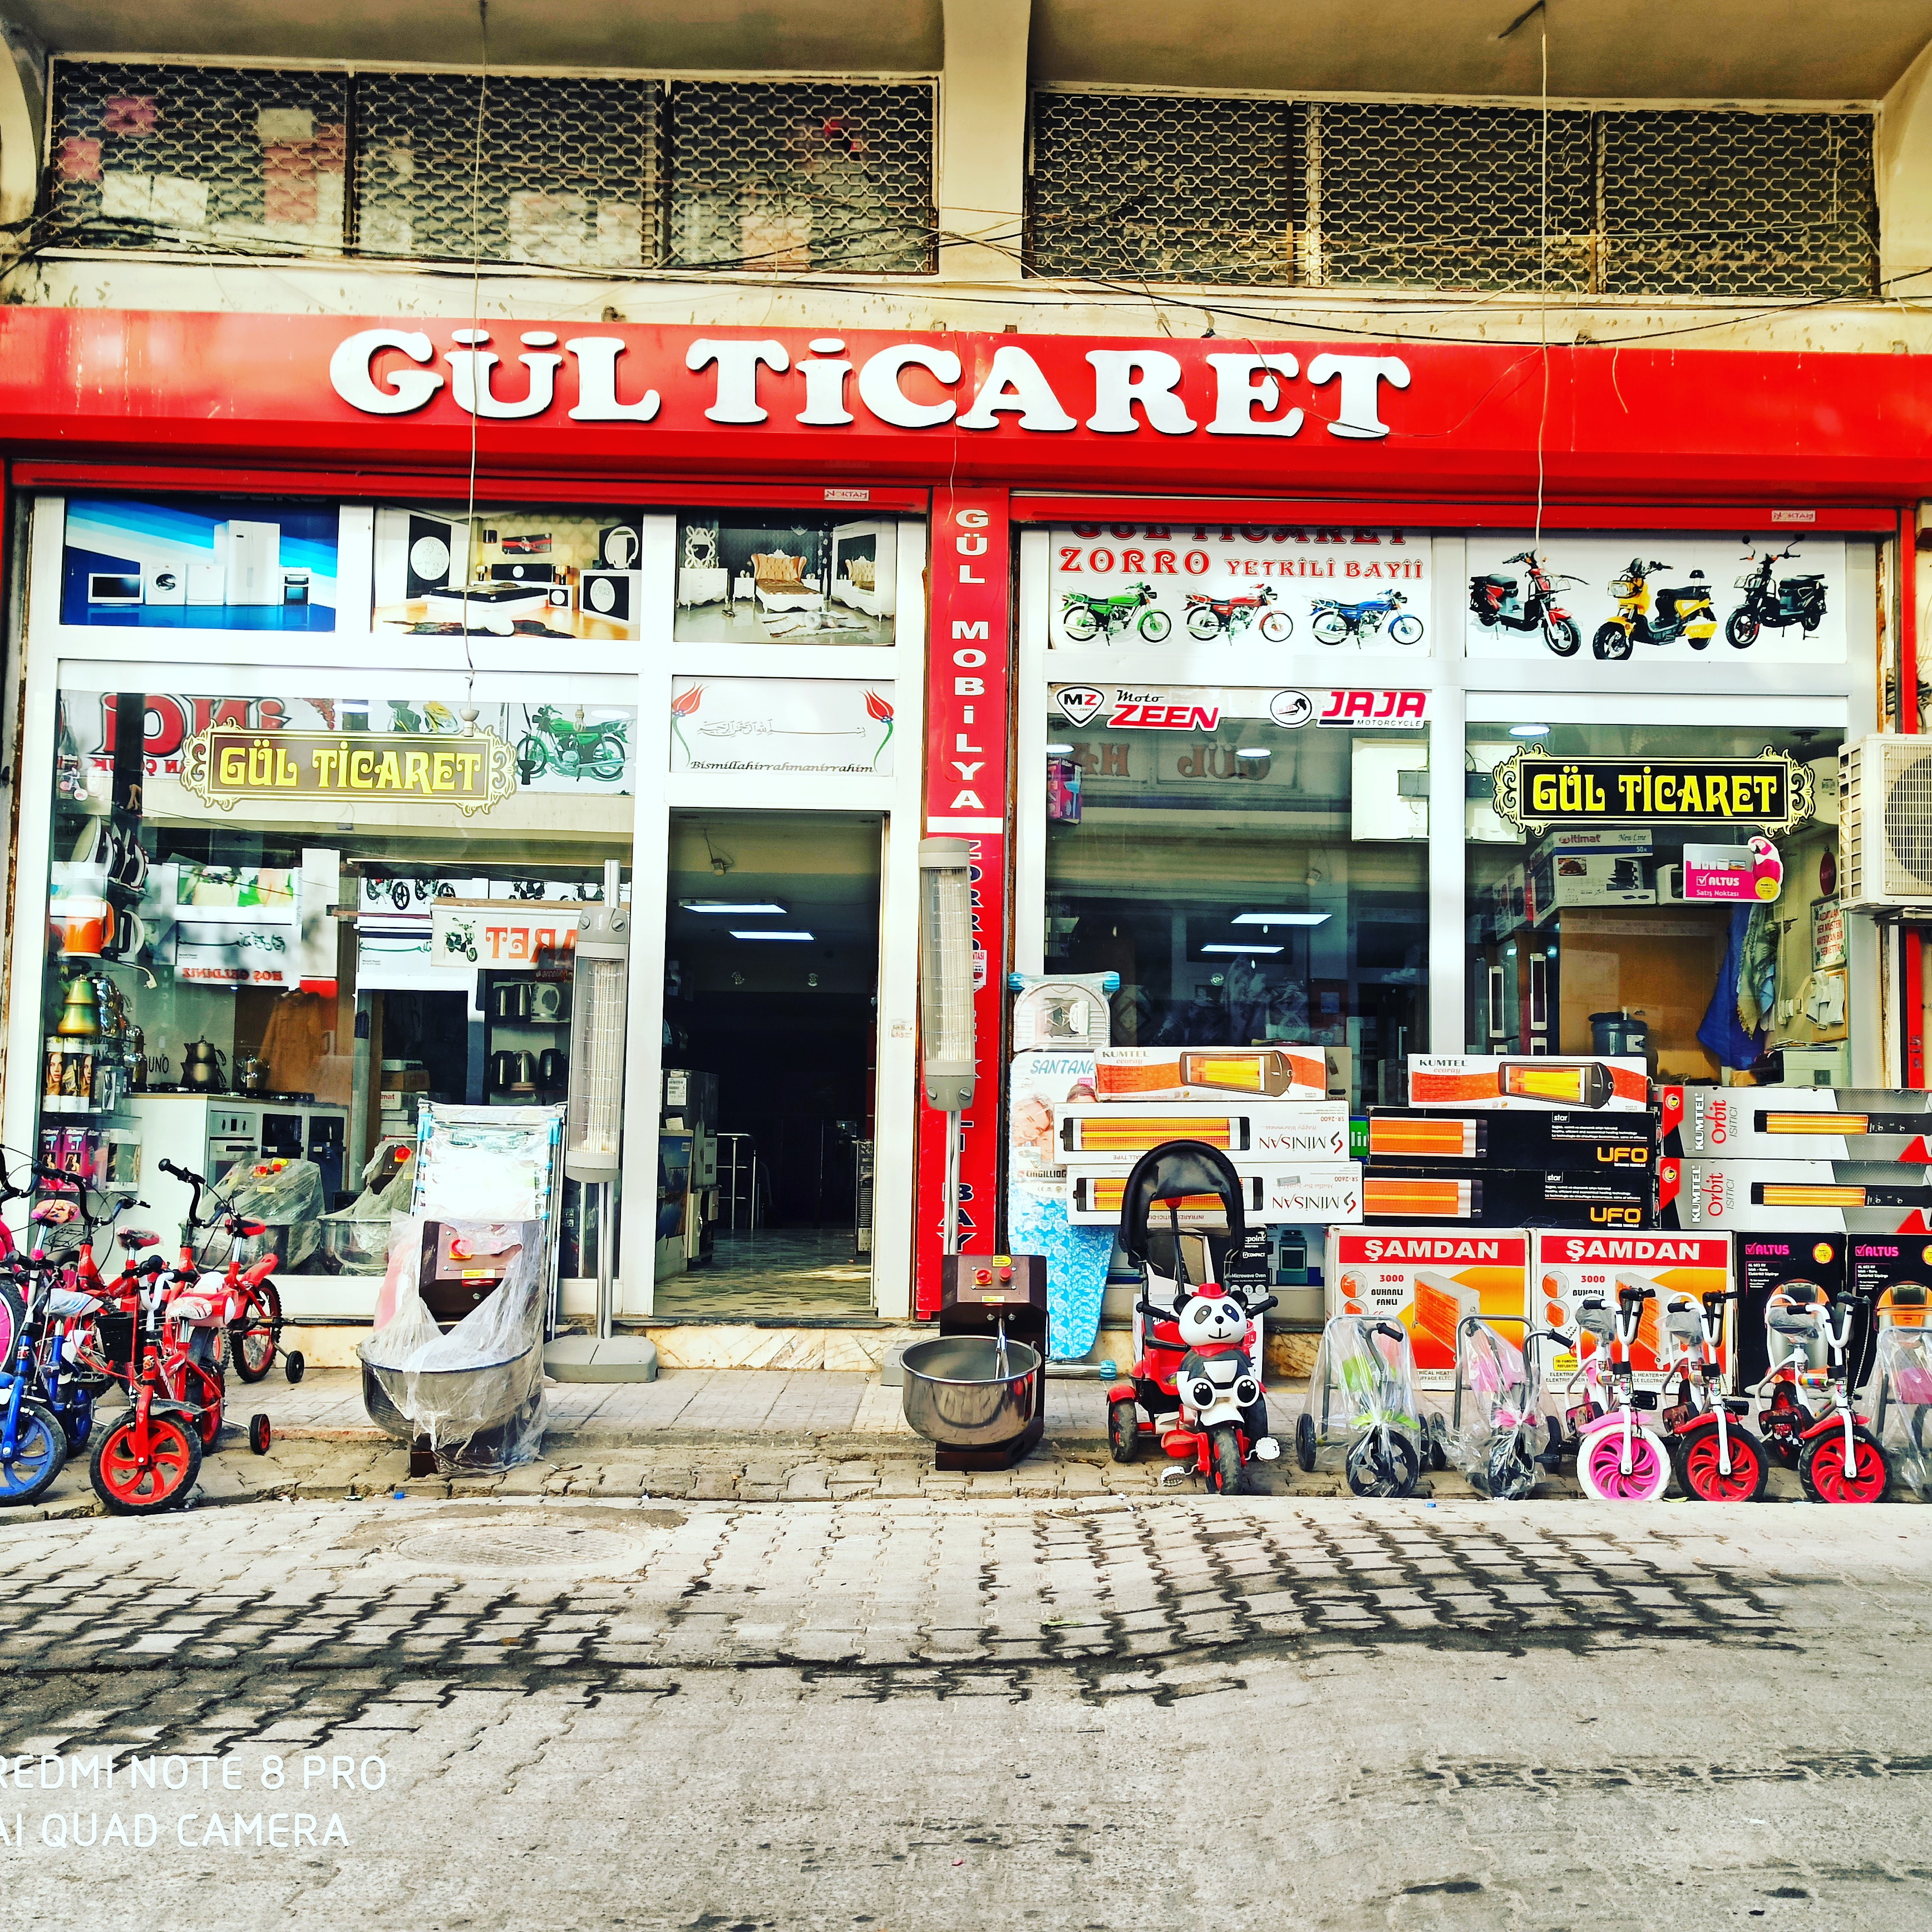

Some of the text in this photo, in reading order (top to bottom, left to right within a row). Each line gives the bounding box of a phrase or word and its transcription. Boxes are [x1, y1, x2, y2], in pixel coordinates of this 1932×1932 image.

[329, 328, 1411, 438] GÜL TİCARET
[955, 508, 989, 584] GÜL
[1059, 546, 1424, 579] ZORRO YETKİLİ BAYİİ
[1064, 694, 1097, 706] MZ
[1117, 689, 1166, 702] Moto
[1322, 691, 1426, 718] JAJA
[949, 620, 990, 810] MOBİLYA
[1110, 704, 1219, 728] ZEEN
[219, 739, 482, 794] GÜL TİCARET
[690, 760, 875, 773] Bismillahirrahmanirrahim
[1532, 766, 1777, 817] GÜL TİCARET
[1708, 876, 1739, 886] ALTUS
[1694, 1092, 1706, 1151] KUMTEL
[1705, 1099, 1727, 1145] Orbit
[1729, 1106, 1738, 1137] ISITICI
[1596, 1146, 1648, 1162] UFO
[1691, 1165, 1702, 1223] KUMTEL
[1702, 1172, 1724, 1217] Orbit
[1726, 1179, 1736, 1210] ISITICI
[1590, 1206, 1641, 1223] UFO
[1364, 1239, 1499, 1262] ŞAMDAN
[1565, 1239, 1701, 1262] ŞAMDAN
[1756, 1244, 1790, 1255] ALTUS
[1865, 1246, 1899, 1257] ALTUS
[1379, 1274, 1404, 1283] 3000
[1581, 1275, 1605, 1283] 3000
